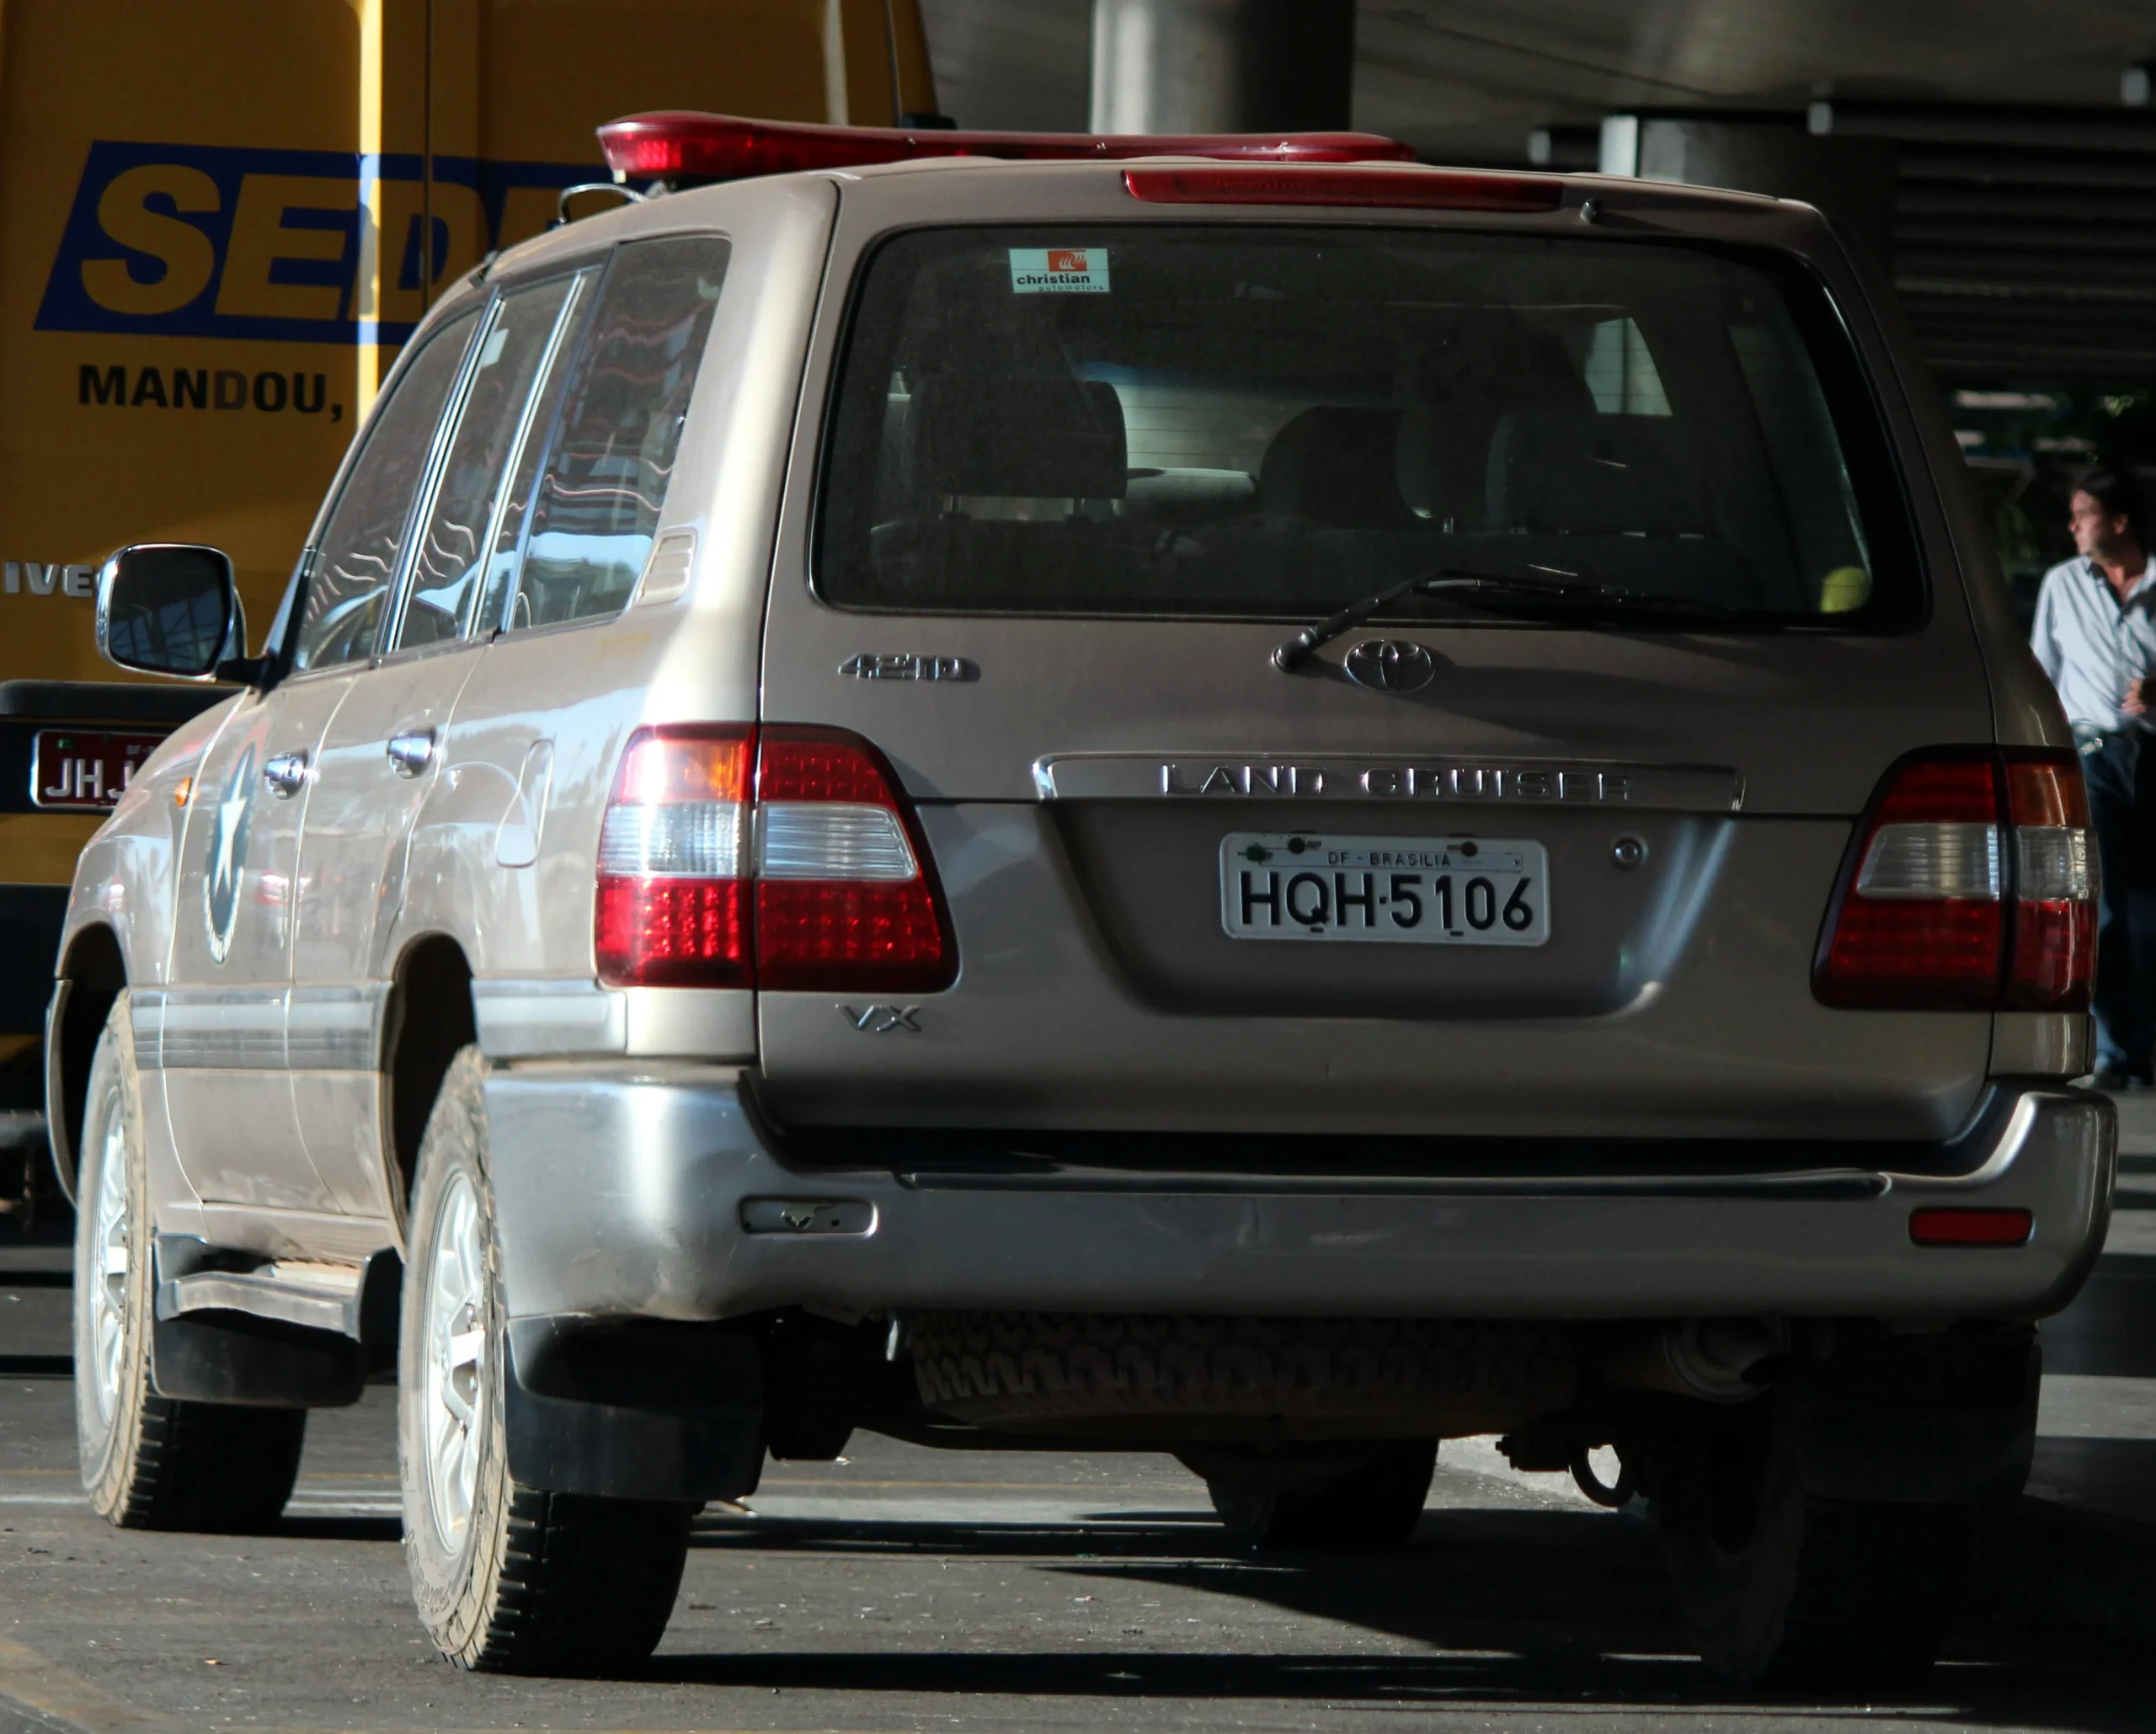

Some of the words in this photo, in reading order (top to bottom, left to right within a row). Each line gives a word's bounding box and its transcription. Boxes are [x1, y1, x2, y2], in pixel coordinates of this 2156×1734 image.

[1016, 273, 1091, 285] christian
[79, 365, 344, 422] MANDOU,
[1161, 762, 1329, 796] LAND
[1360, 766, 1630, 801] CRUISER
[1328, 852, 1348, 865] DF
[1370, 852, 1451, 867] BRASILIA
[835, 1003, 921, 1032] VX
